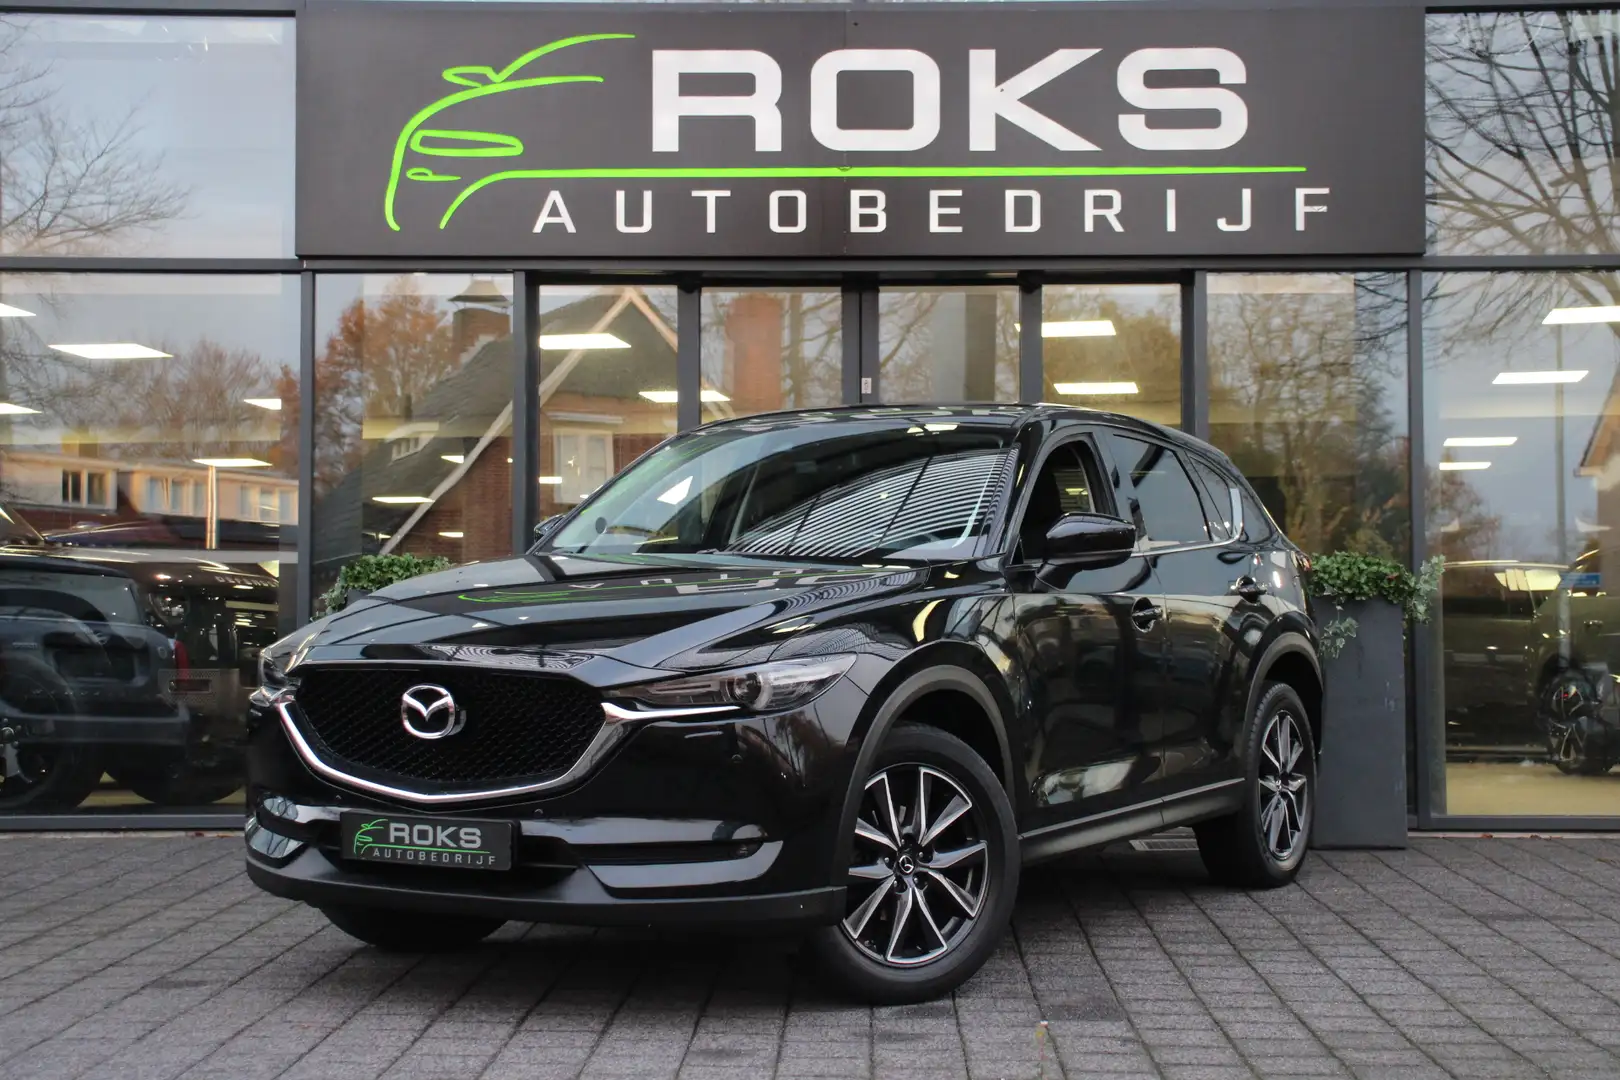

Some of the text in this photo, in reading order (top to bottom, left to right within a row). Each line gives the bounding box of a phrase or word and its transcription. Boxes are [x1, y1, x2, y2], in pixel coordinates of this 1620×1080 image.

[652, 47, 1249, 152] ROKS
[532, 187, 1329, 233] AUTOBEDRIJF
[389, 822, 482, 849] ROKS
[372, 848, 496, 865] AUTOBEDRIJF
